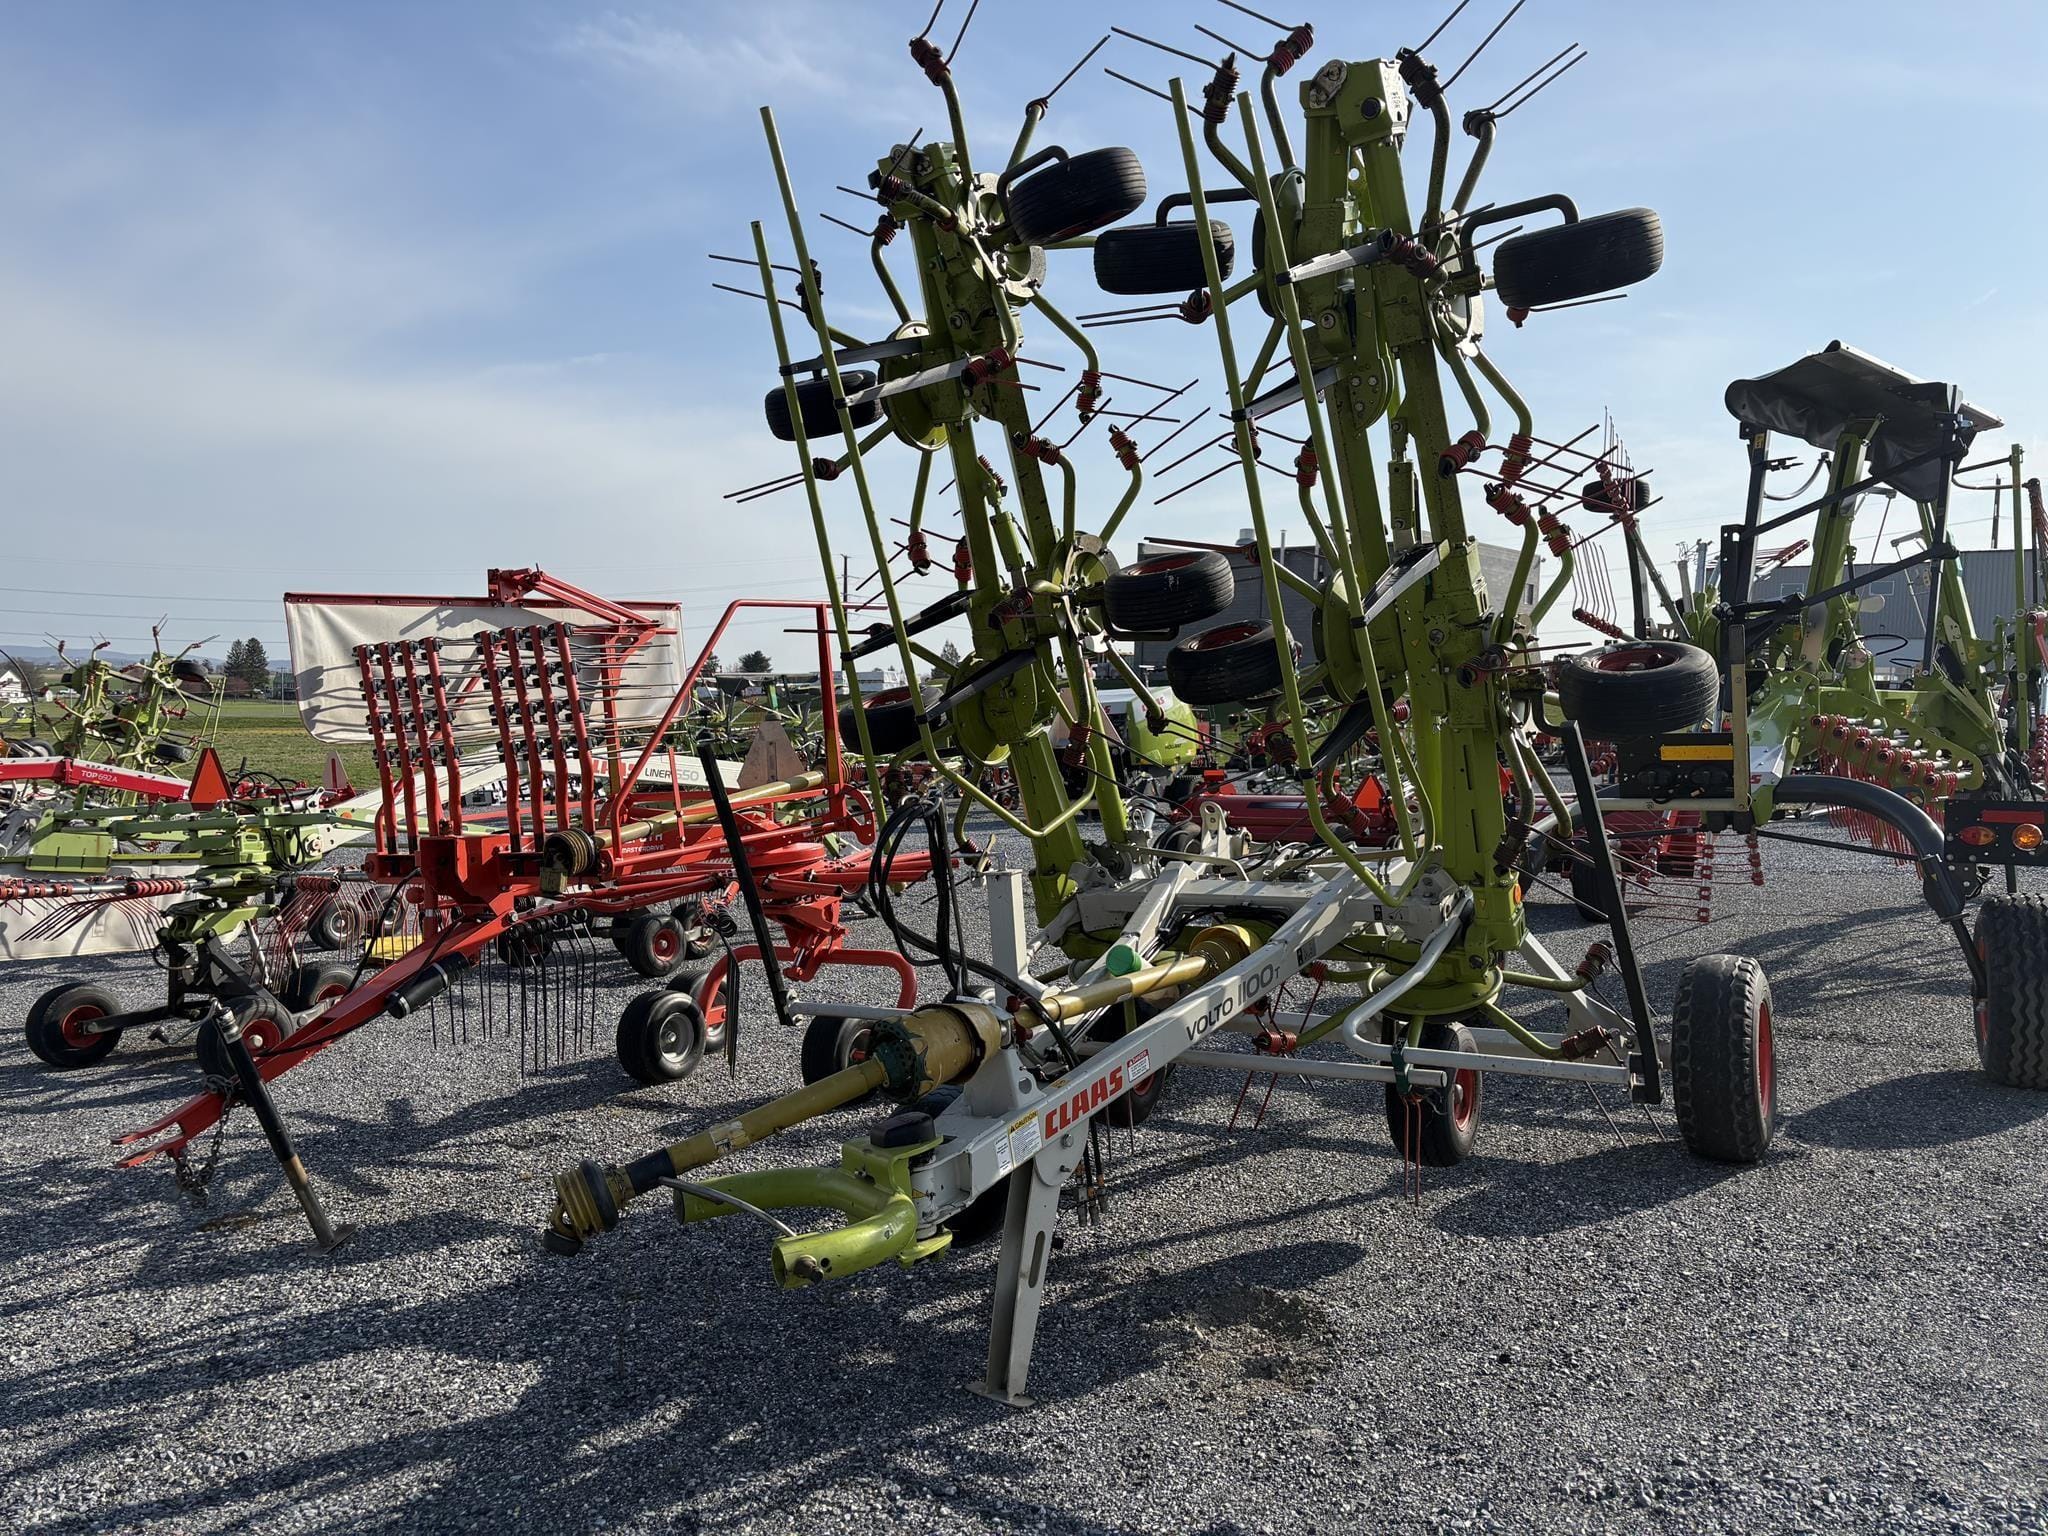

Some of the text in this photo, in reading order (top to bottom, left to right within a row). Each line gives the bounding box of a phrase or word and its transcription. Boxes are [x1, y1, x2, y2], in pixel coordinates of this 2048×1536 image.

[81, 770, 98, 779] TOP
[645, 768, 671, 778] LINER
[1186, 997, 1233, 1041] VOLTO
[1045, 1066, 1122, 1139] CLAAS
[1014, 1110, 1037, 1130] CAUTION
